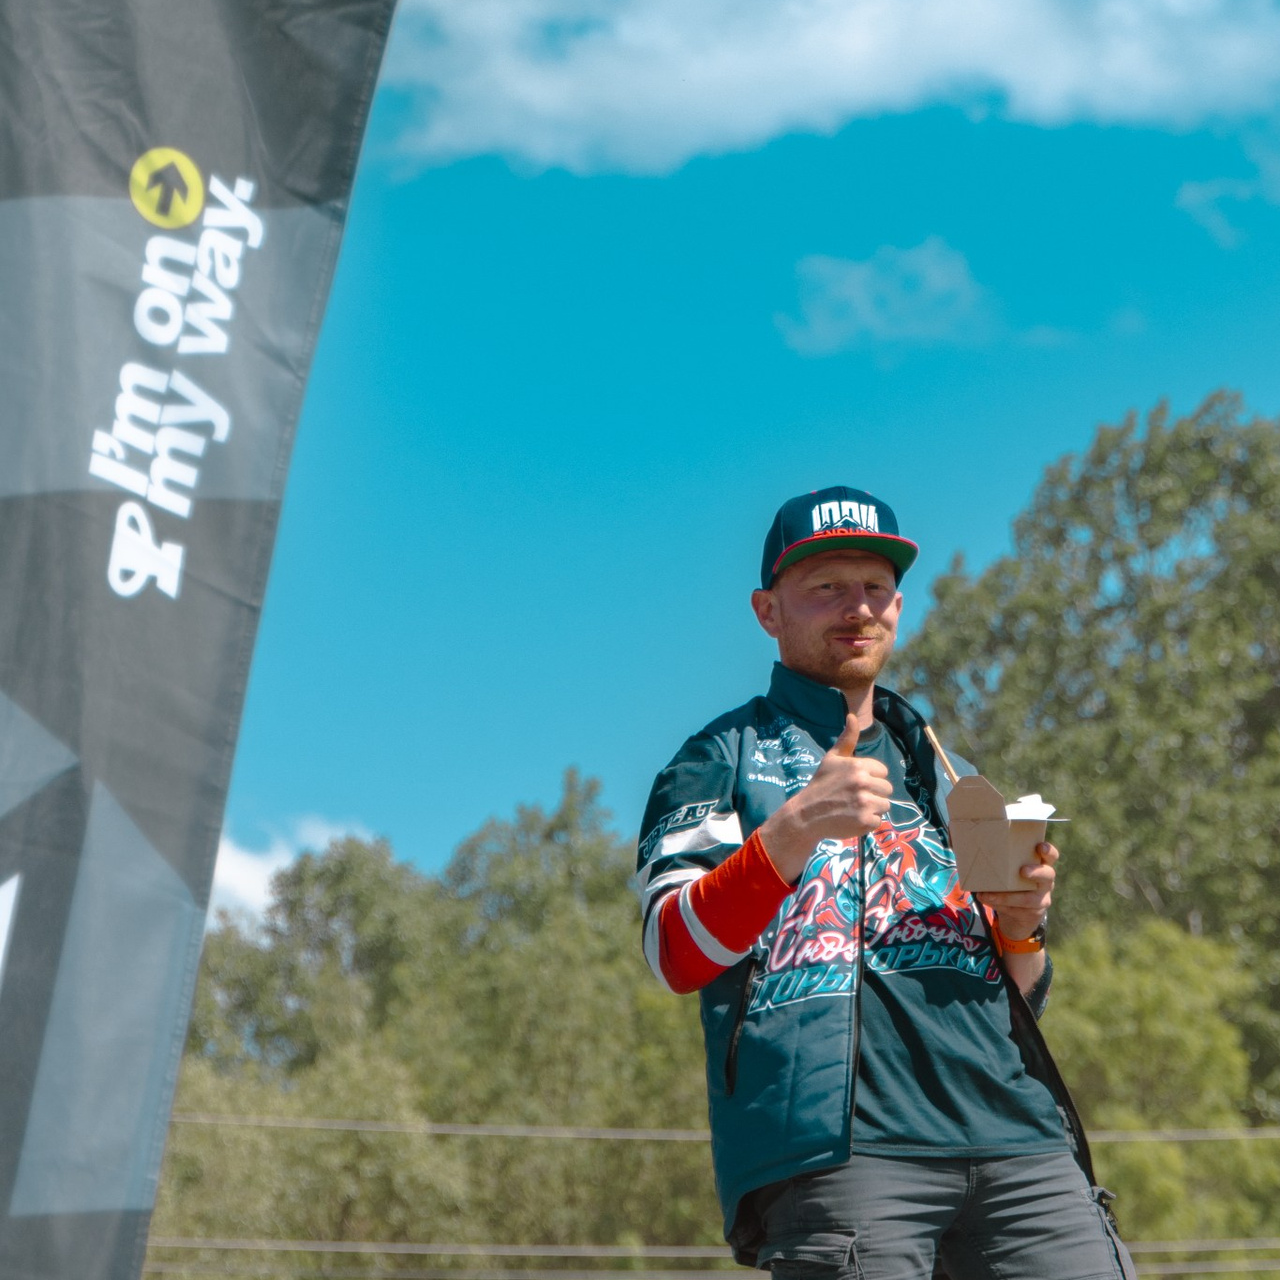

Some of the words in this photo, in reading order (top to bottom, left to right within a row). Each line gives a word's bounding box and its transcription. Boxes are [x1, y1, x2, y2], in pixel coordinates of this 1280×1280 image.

[177, 175, 264, 355] way.
[88, 361, 170, 497] I'm
[133, 235, 199, 346] on
[146, 369, 231, 519] my
[107, 500, 185, 600] &
